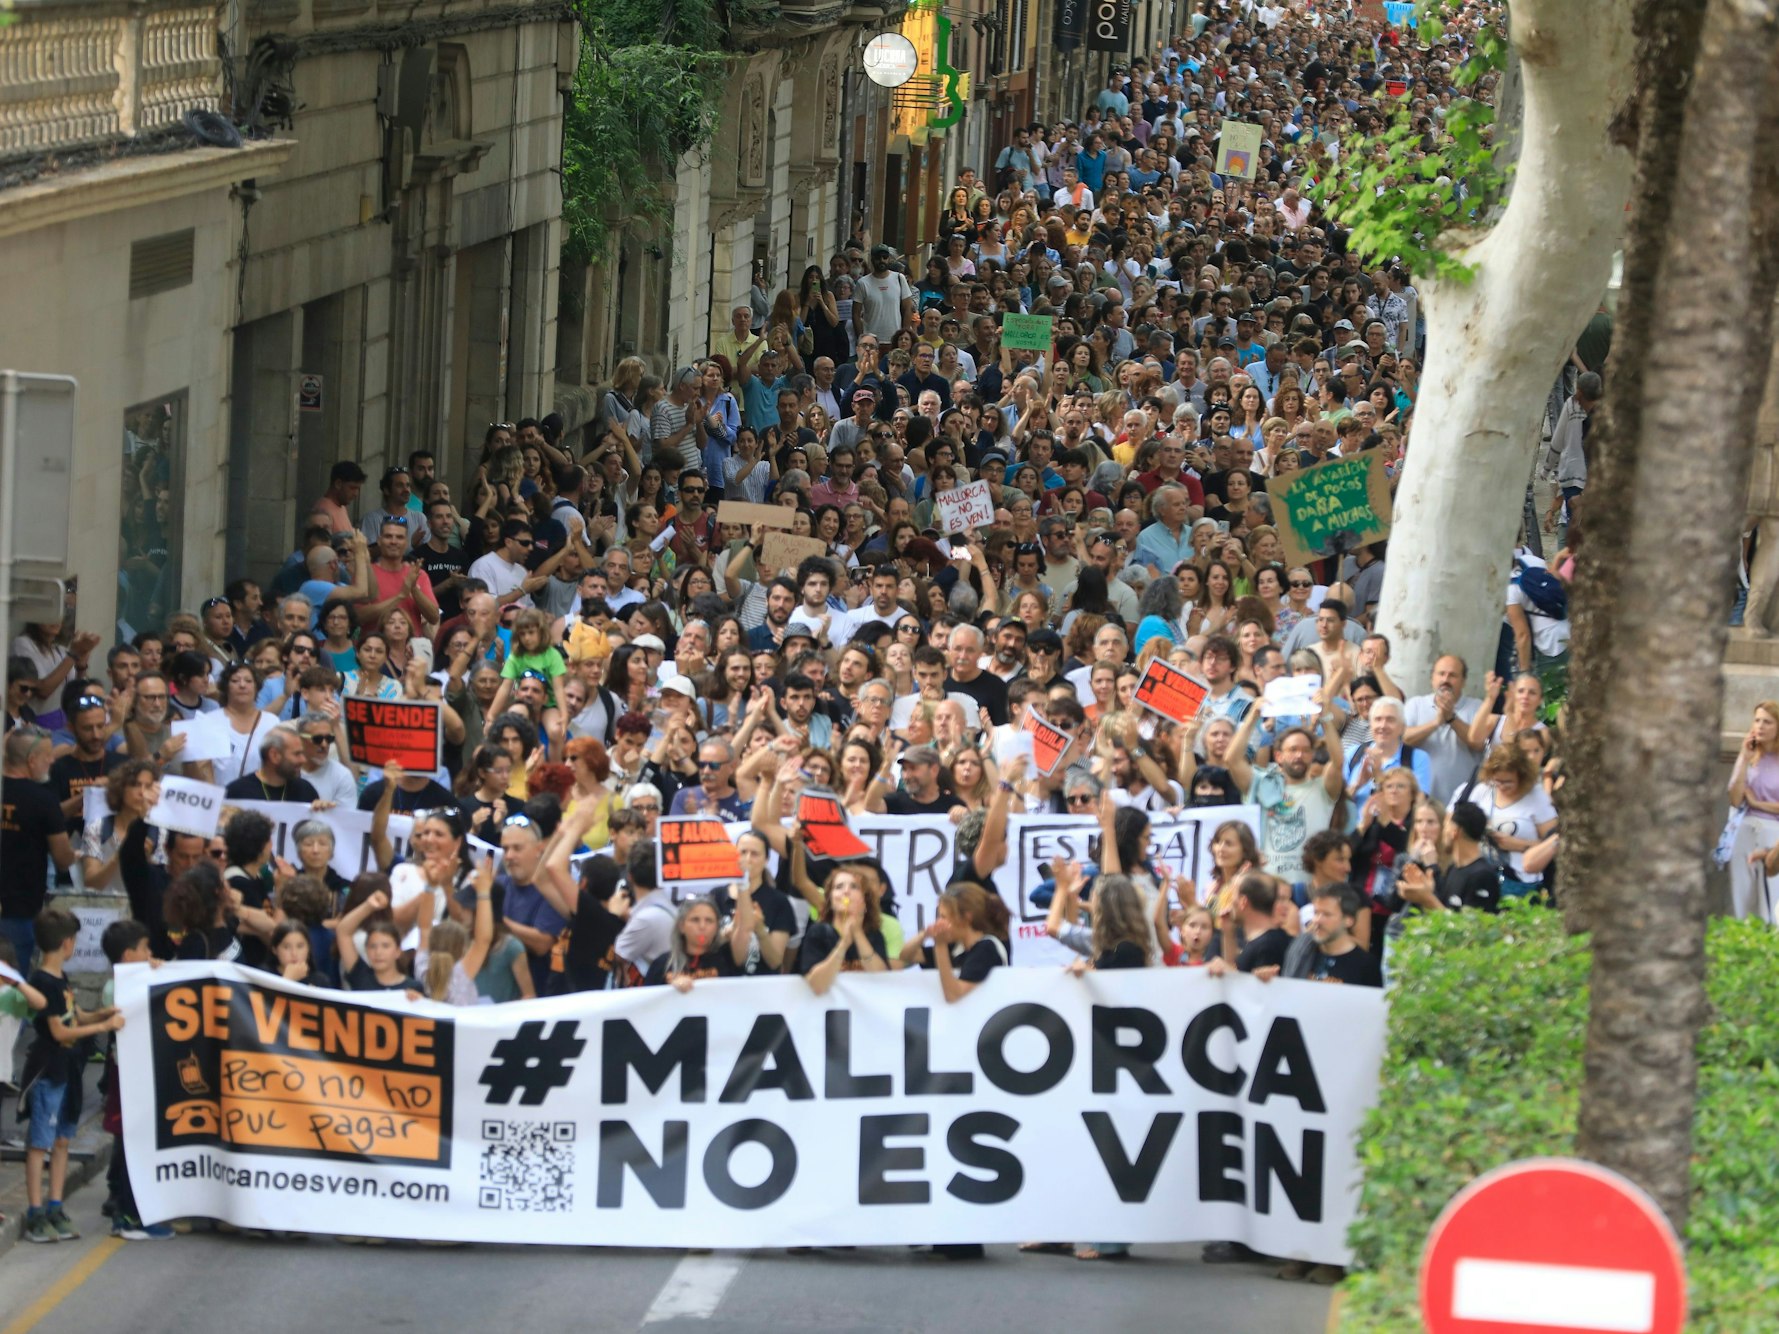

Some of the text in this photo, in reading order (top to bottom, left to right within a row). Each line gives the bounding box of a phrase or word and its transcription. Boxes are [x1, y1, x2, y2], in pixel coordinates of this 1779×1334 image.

[938, 484, 987, 508] MALLORCA
[1291, 480, 1307, 494] LA
[1304, 475, 1362, 502] DE POCOS
[958, 501, 973, 515] NO
[1312, 503, 1374, 533] A MUCHOS
[949, 516, 963, 530] ES
[783, 546, 799, 557] NO
[346, 700, 436, 729] SE VENDE
[165, 789, 213, 811] PROU
[662, 821, 680, 844] SE
[1032, 835, 1075, 861] ES
[164, 986, 437, 1068] SE VENDE
[478, 1002, 1328, 1114] #MALLORCA
[222, 1058, 432, 1110] Però no ho
[308, 1111, 420, 1152] pagar
[155, 1153, 451, 1201] mallorcanoesven.com
[596, 1110, 1326, 1223] NO ES VEN
